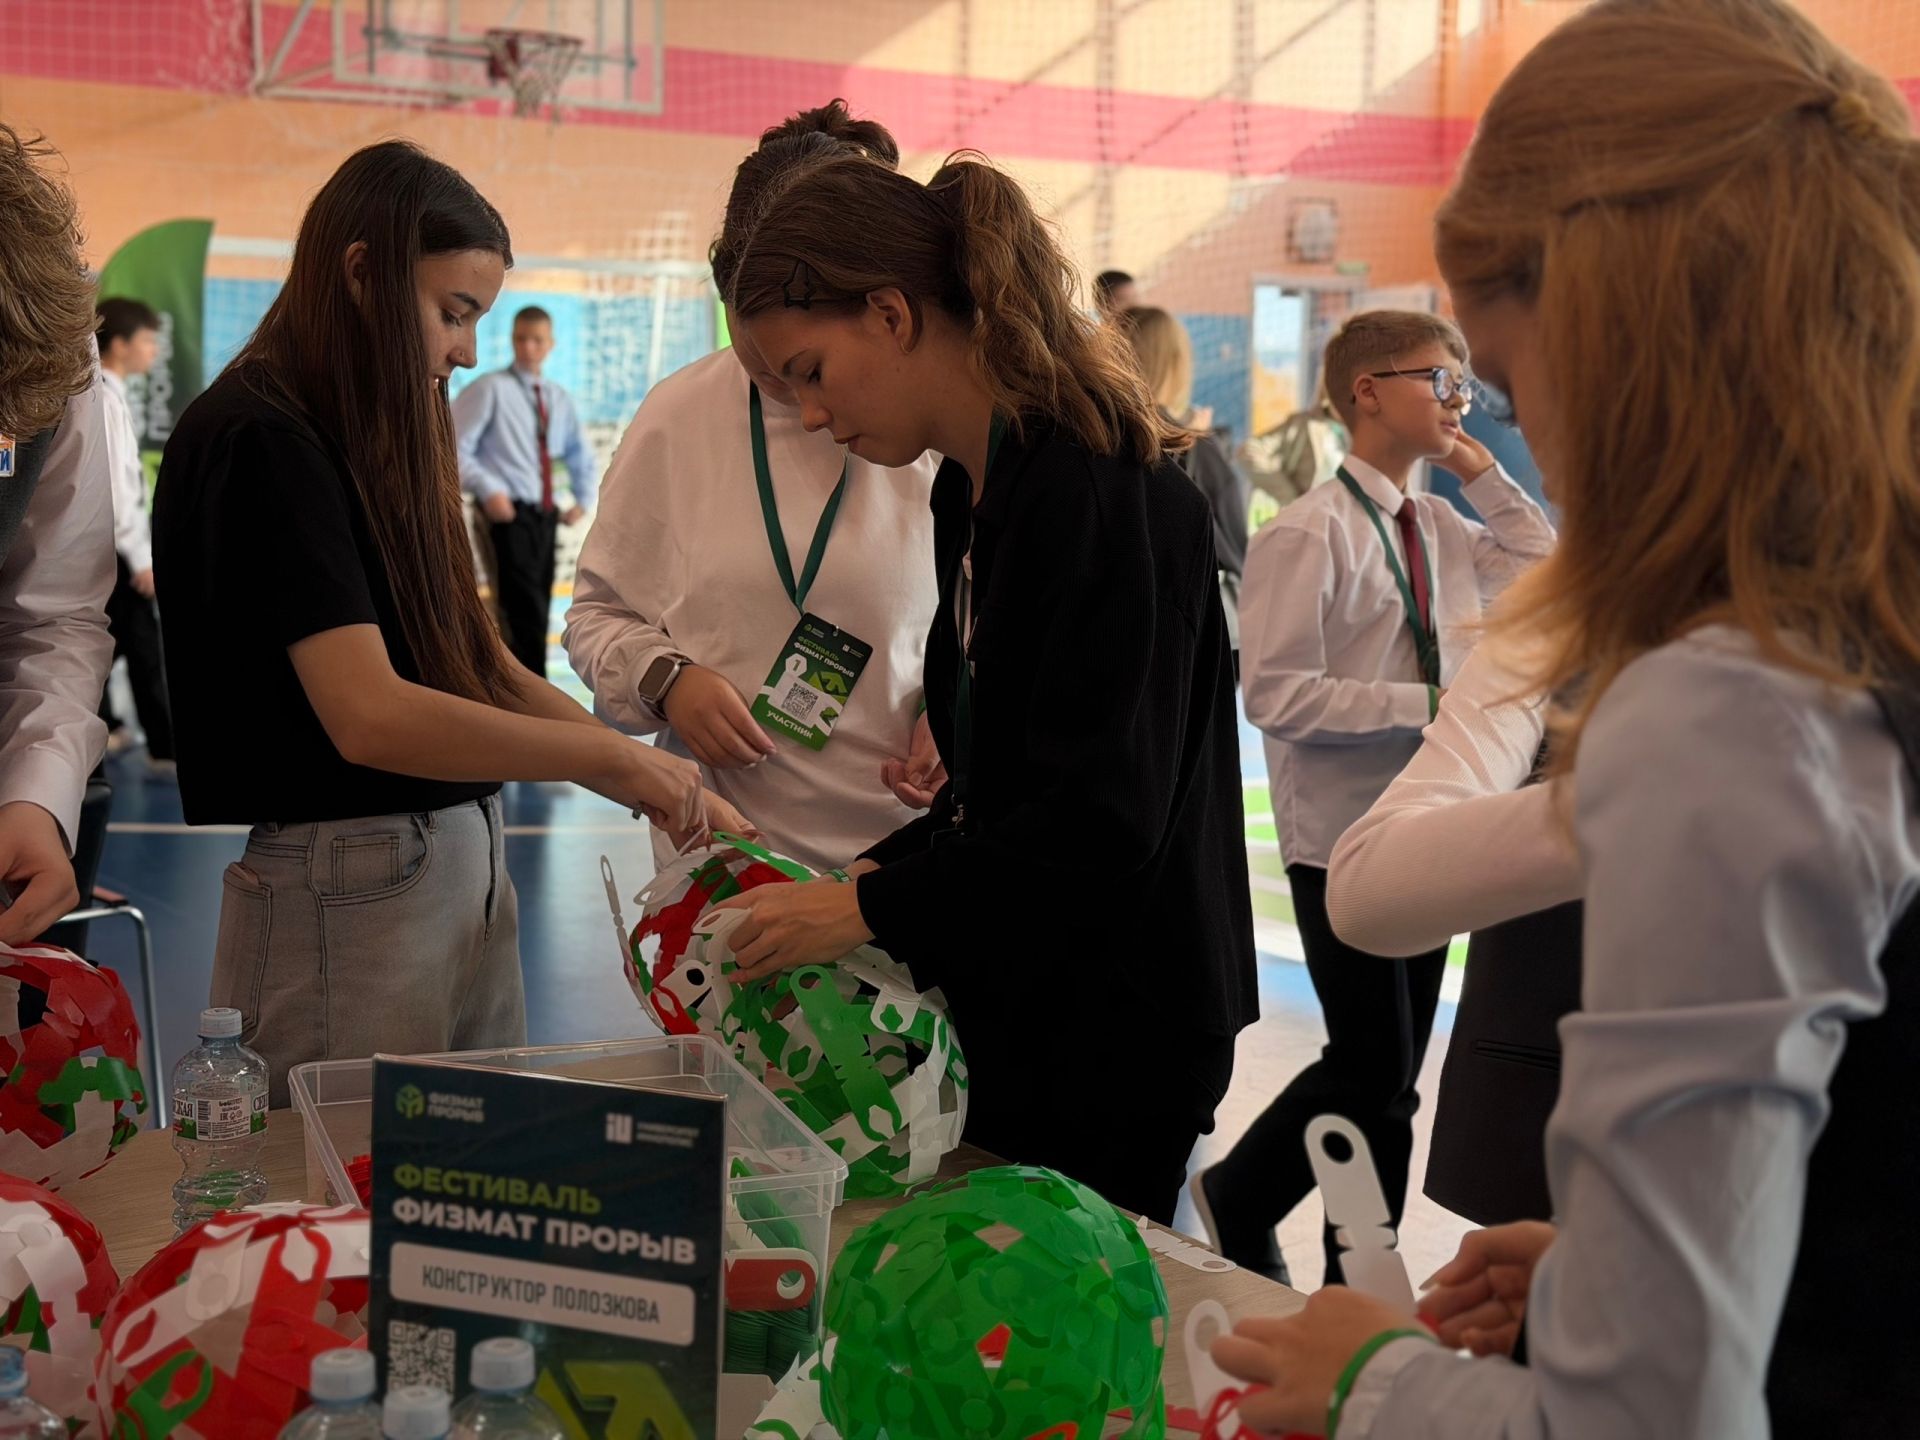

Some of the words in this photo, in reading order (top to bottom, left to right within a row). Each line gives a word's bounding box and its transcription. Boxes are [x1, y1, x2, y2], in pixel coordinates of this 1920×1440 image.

[794, 642, 823, 661] ФИЗМАТ
[824, 658, 854, 677] ПРОРЫВ
[767, 710, 813, 739] УЧАСТНИК
[393, 1162, 602, 1215] ФЕСТИВАЛЬ
[392, 1196, 538, 1242] ФИЗМАТ
[544, 1219, 696, 1265] ПРОРЫВ
[422, 1264, 547, 1305] КОНСТРУКТОР
[552, 1284, 660, 1324] ПОЛОЗКОВА
